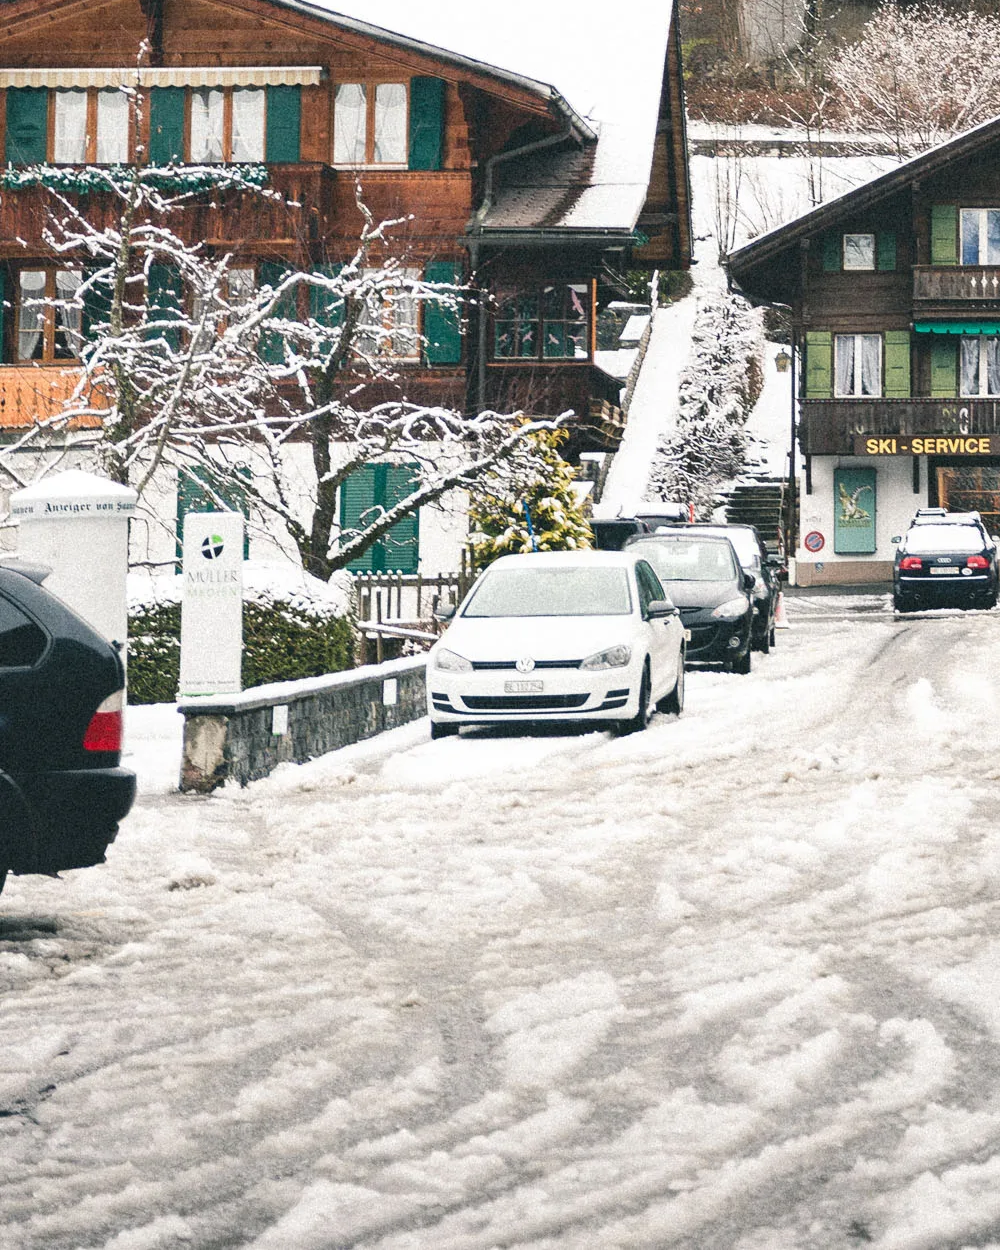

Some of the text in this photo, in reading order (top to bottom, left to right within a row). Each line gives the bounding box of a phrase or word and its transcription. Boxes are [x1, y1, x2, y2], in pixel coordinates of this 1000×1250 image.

[866, 438, 897, 454] SKI
[911, 438, 991, 454] SERVICE
[96, 502, 113, 511] von
